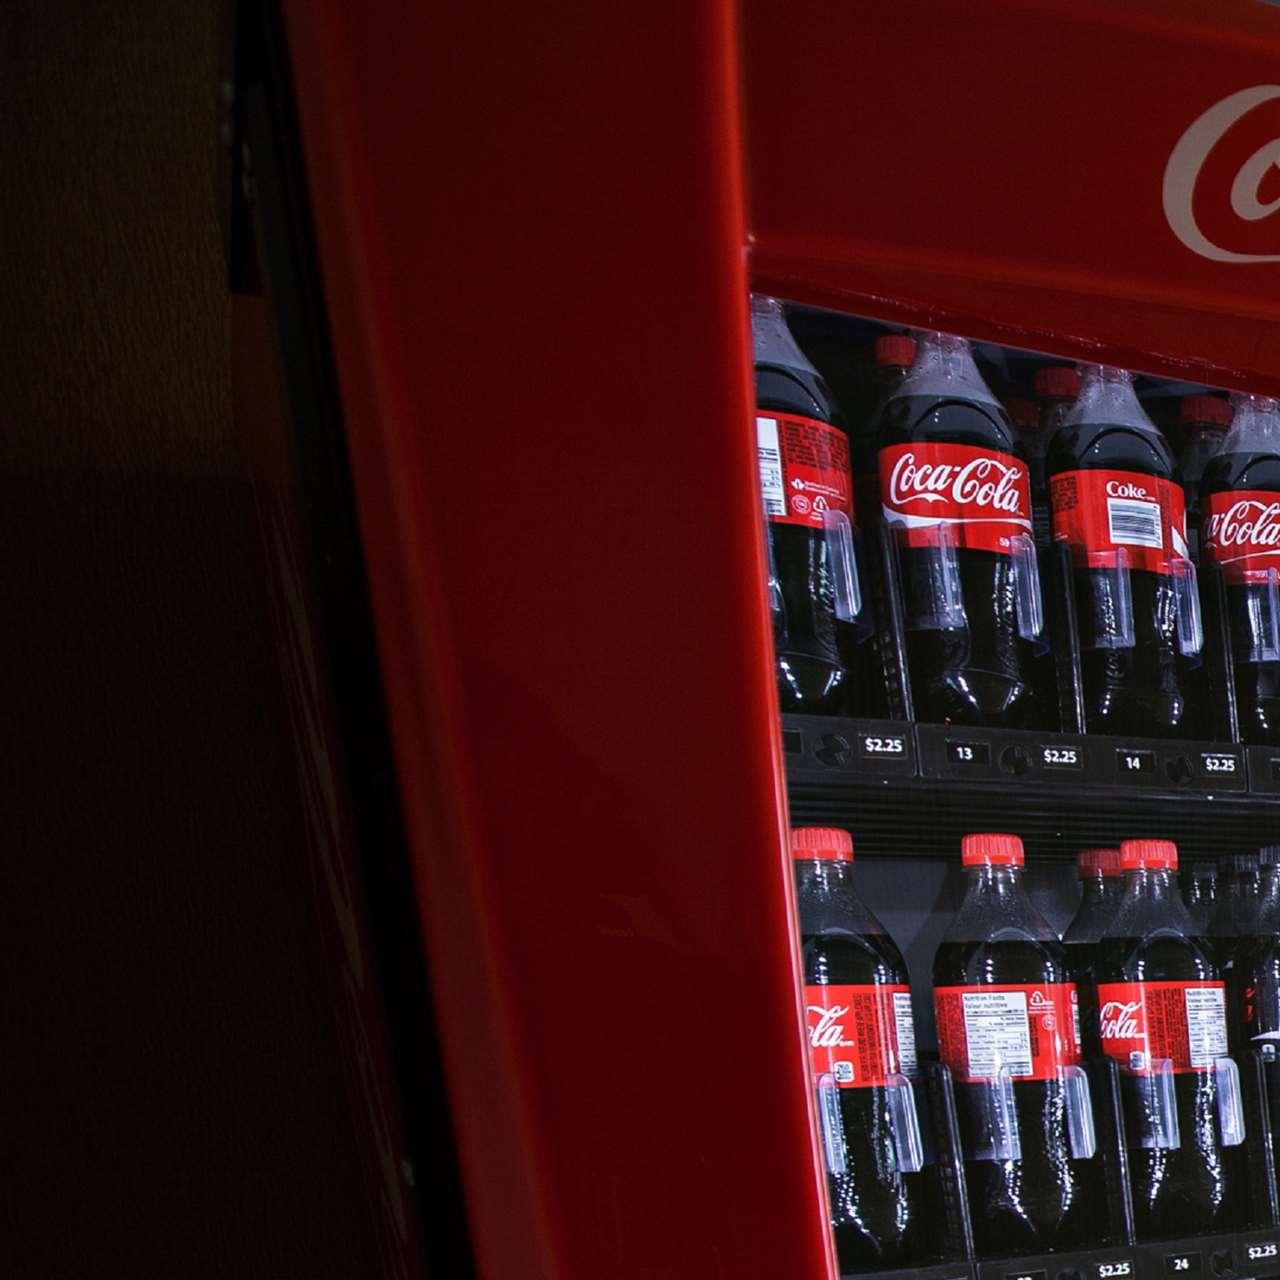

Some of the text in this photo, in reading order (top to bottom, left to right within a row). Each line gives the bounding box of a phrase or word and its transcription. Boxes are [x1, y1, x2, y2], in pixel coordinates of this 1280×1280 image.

[890, 452, 1020, 512] Coca-Cola
[1106, 481, 1146, 499] Coke
[865, 737, 902, 754] $2.25
[956, 747, 973, 761] 13
[1044, 749, 1077, 765] $2.25
[1126, 757, 1140, 770] 14
[1205, 758, 1235, 772] $2.25
[1248, 1244, 1277, 1259] $2.25
[1099, 1262, 1131, 1277] $2.25
[1173, 1258, 1190, 1271] 24
